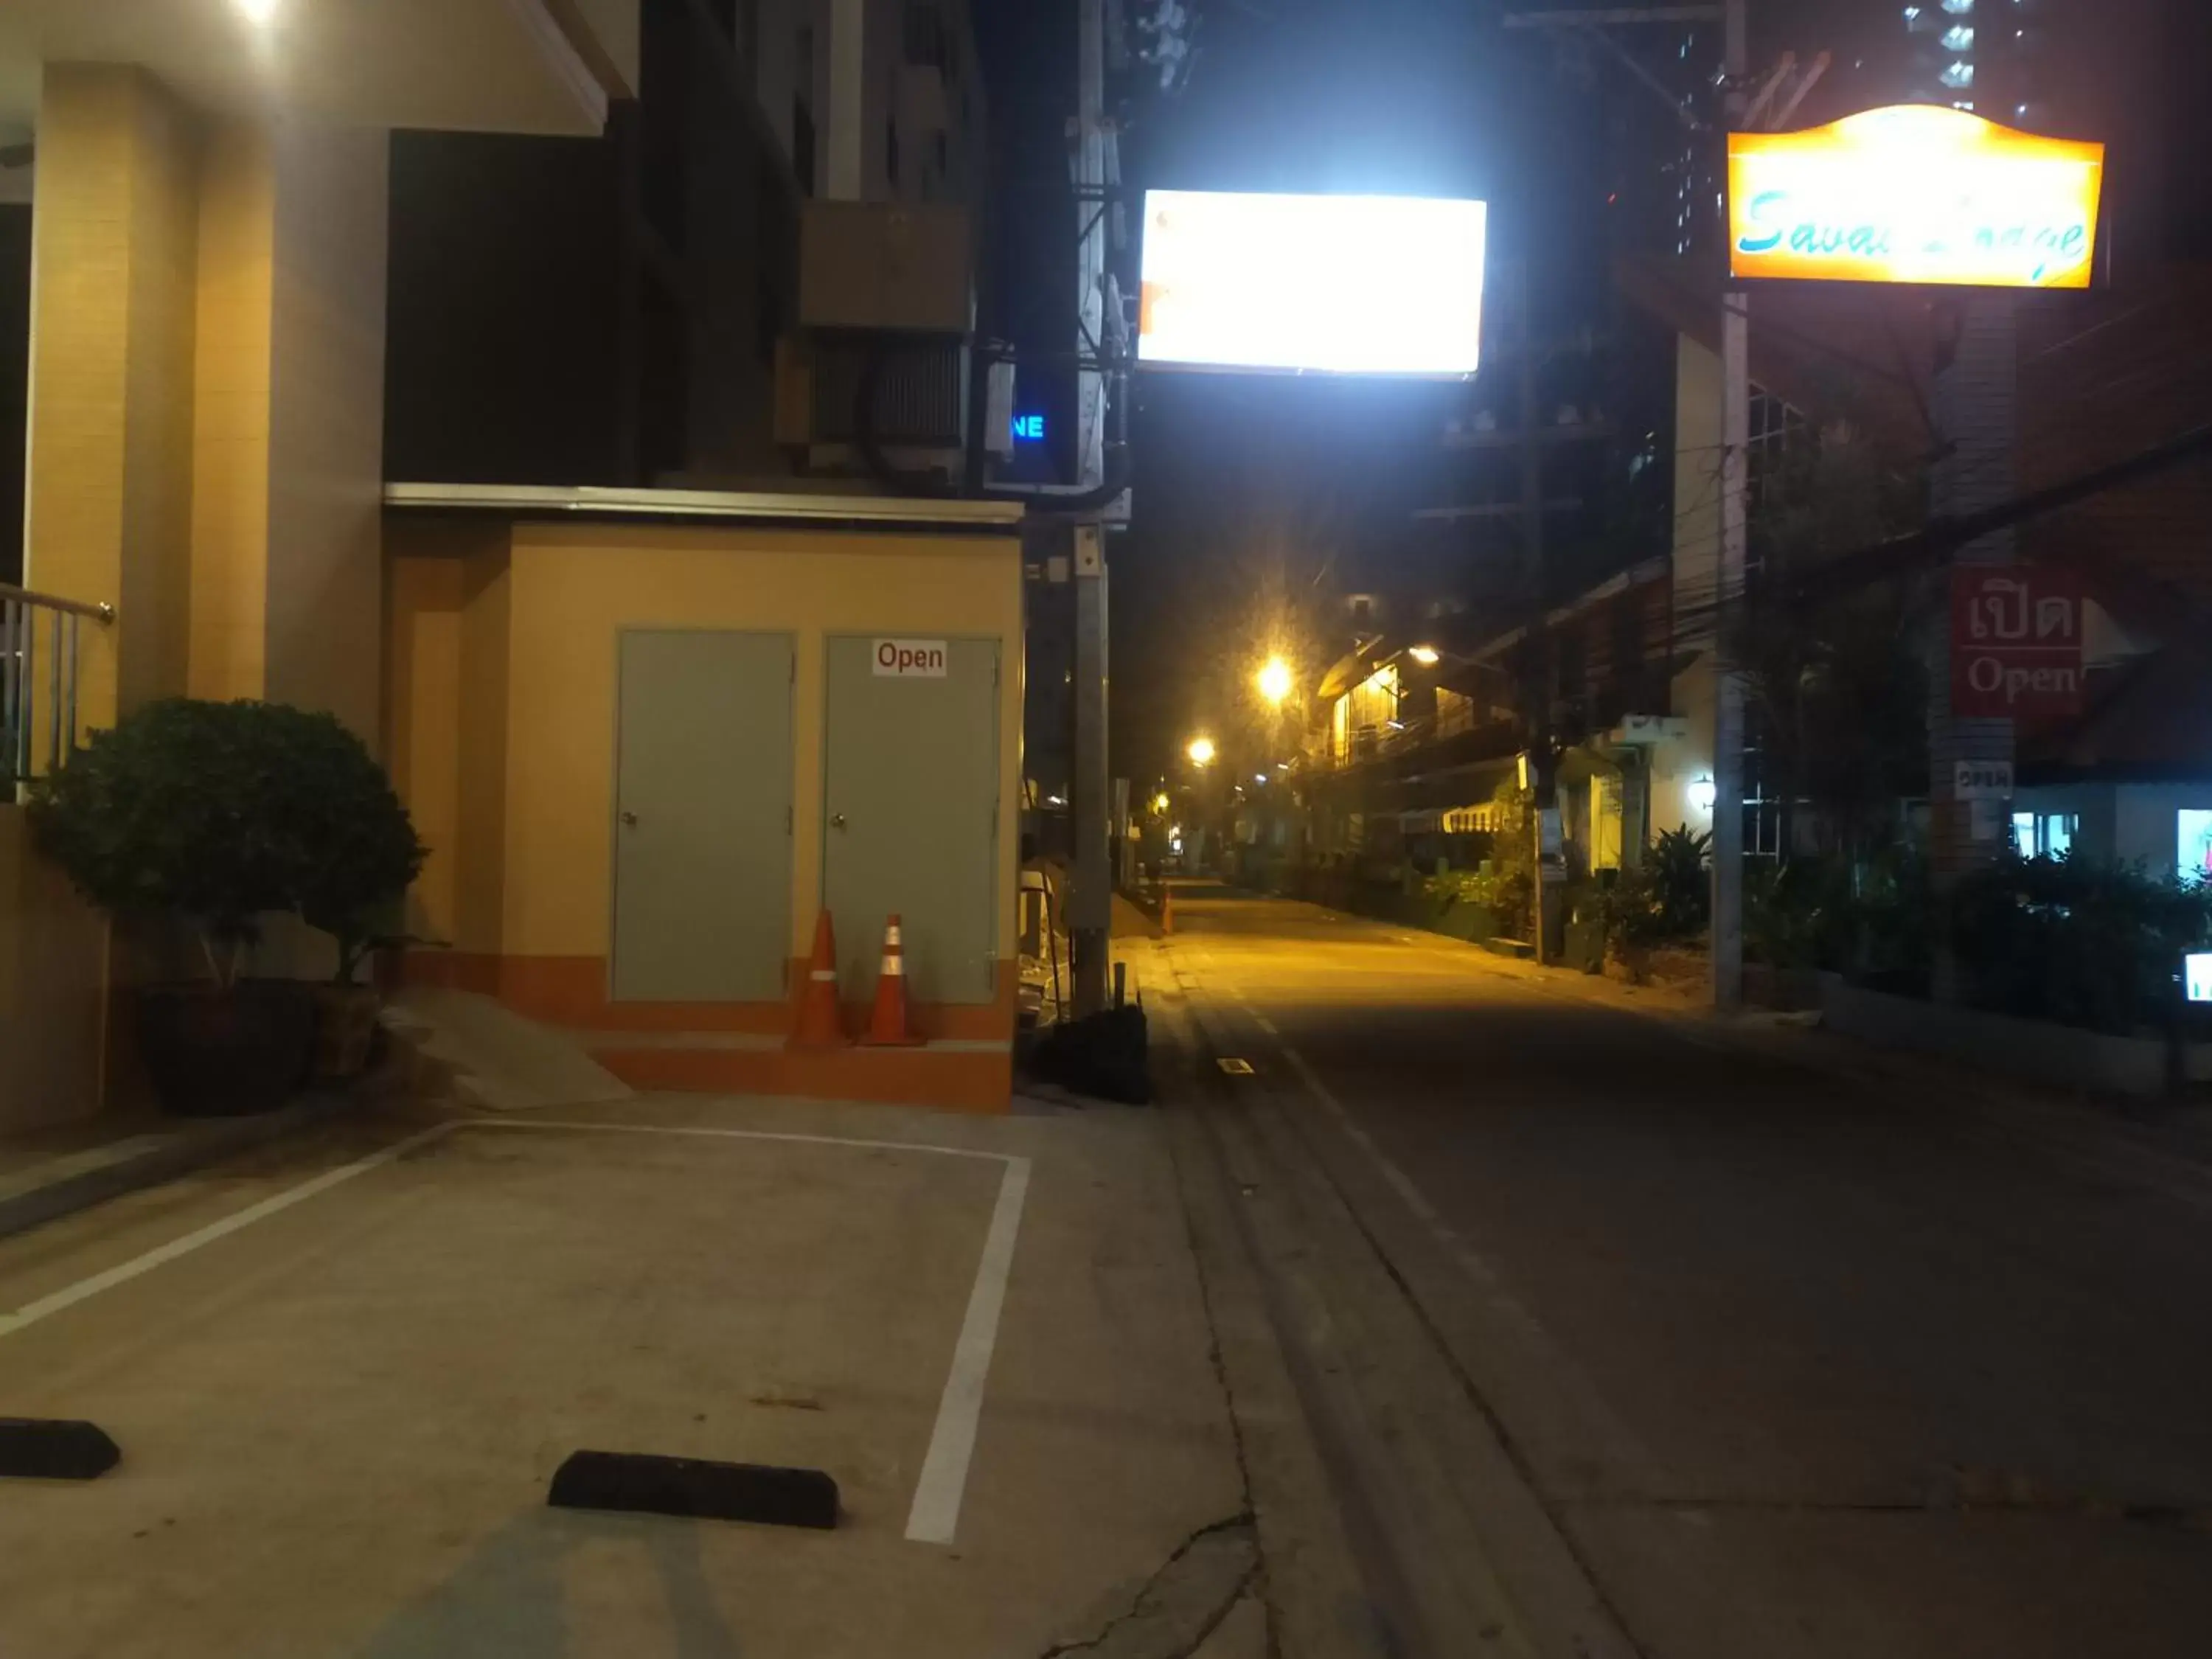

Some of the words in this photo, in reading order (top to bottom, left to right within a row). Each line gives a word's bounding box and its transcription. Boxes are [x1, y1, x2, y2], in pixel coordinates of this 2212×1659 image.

[1969, 577, 2073, 639] เปิด
[878, 642, 942, 673] Open
[1968, 655, 2076, 704] Open
